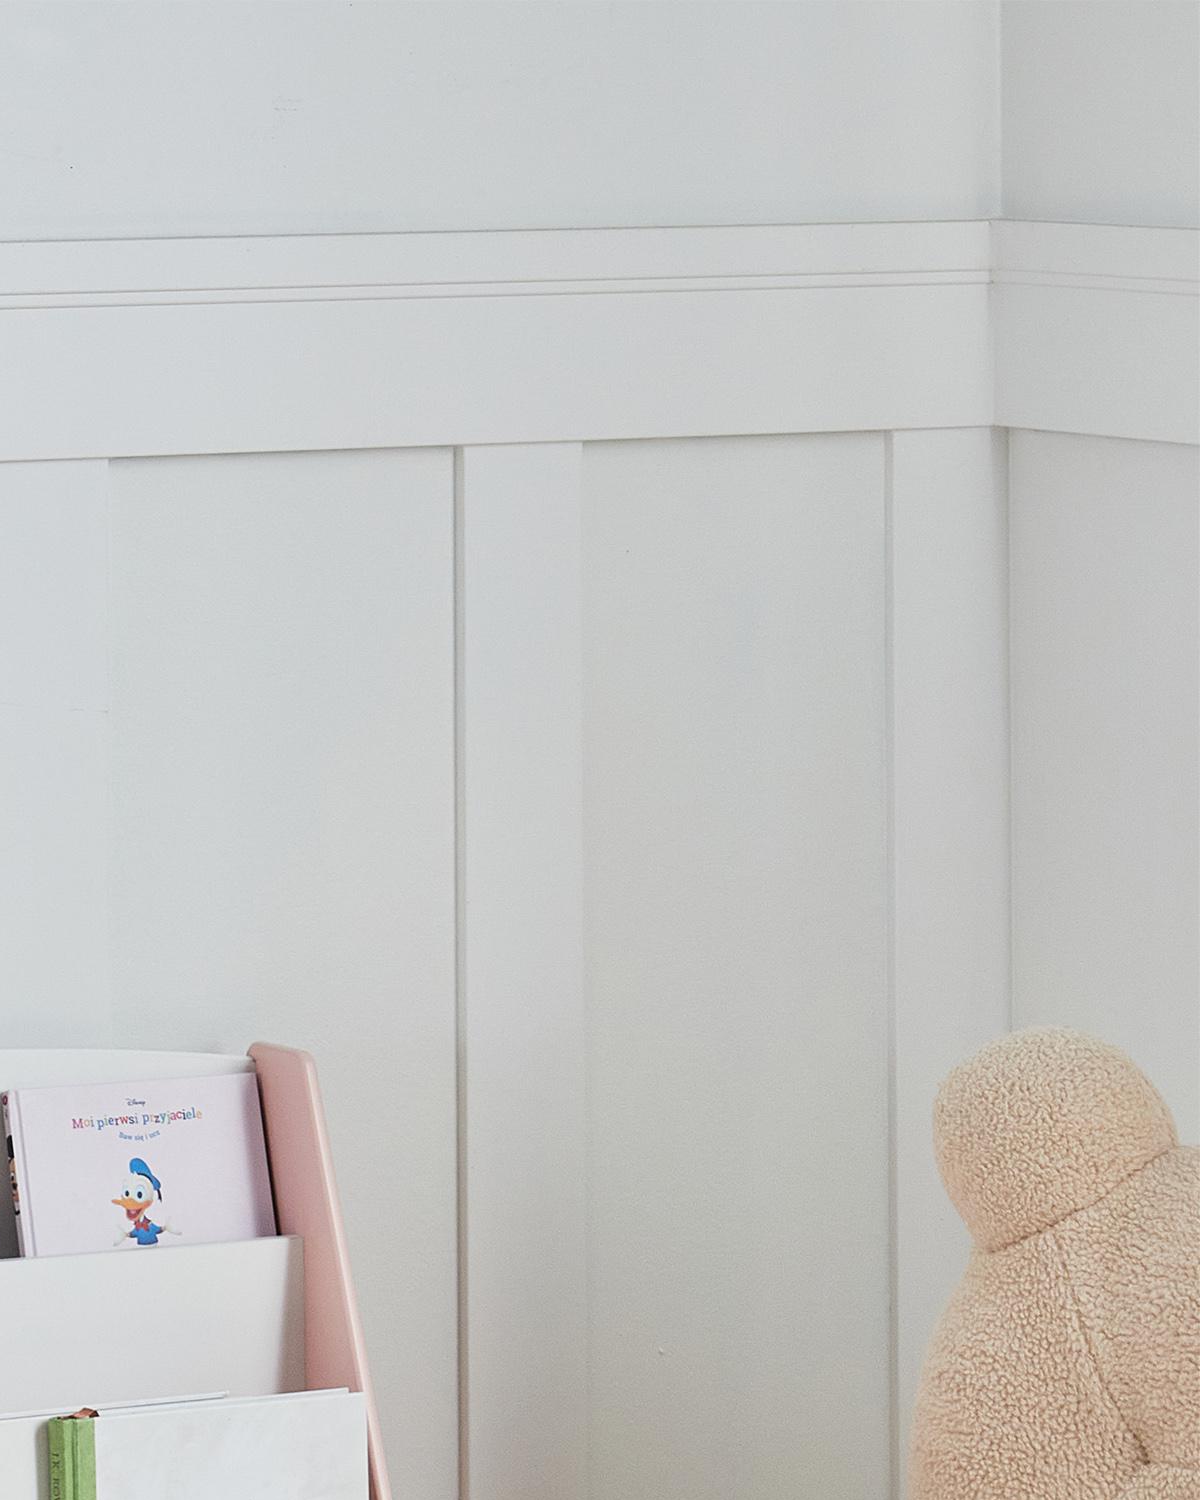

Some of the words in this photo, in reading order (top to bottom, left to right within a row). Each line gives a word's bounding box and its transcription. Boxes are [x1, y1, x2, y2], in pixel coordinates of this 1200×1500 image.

[71, 1116, 95, 1129] Moi
[97, 1113, 139, 1130] pierwsi
[142, 1107, 203, 1126] przyjaciele
